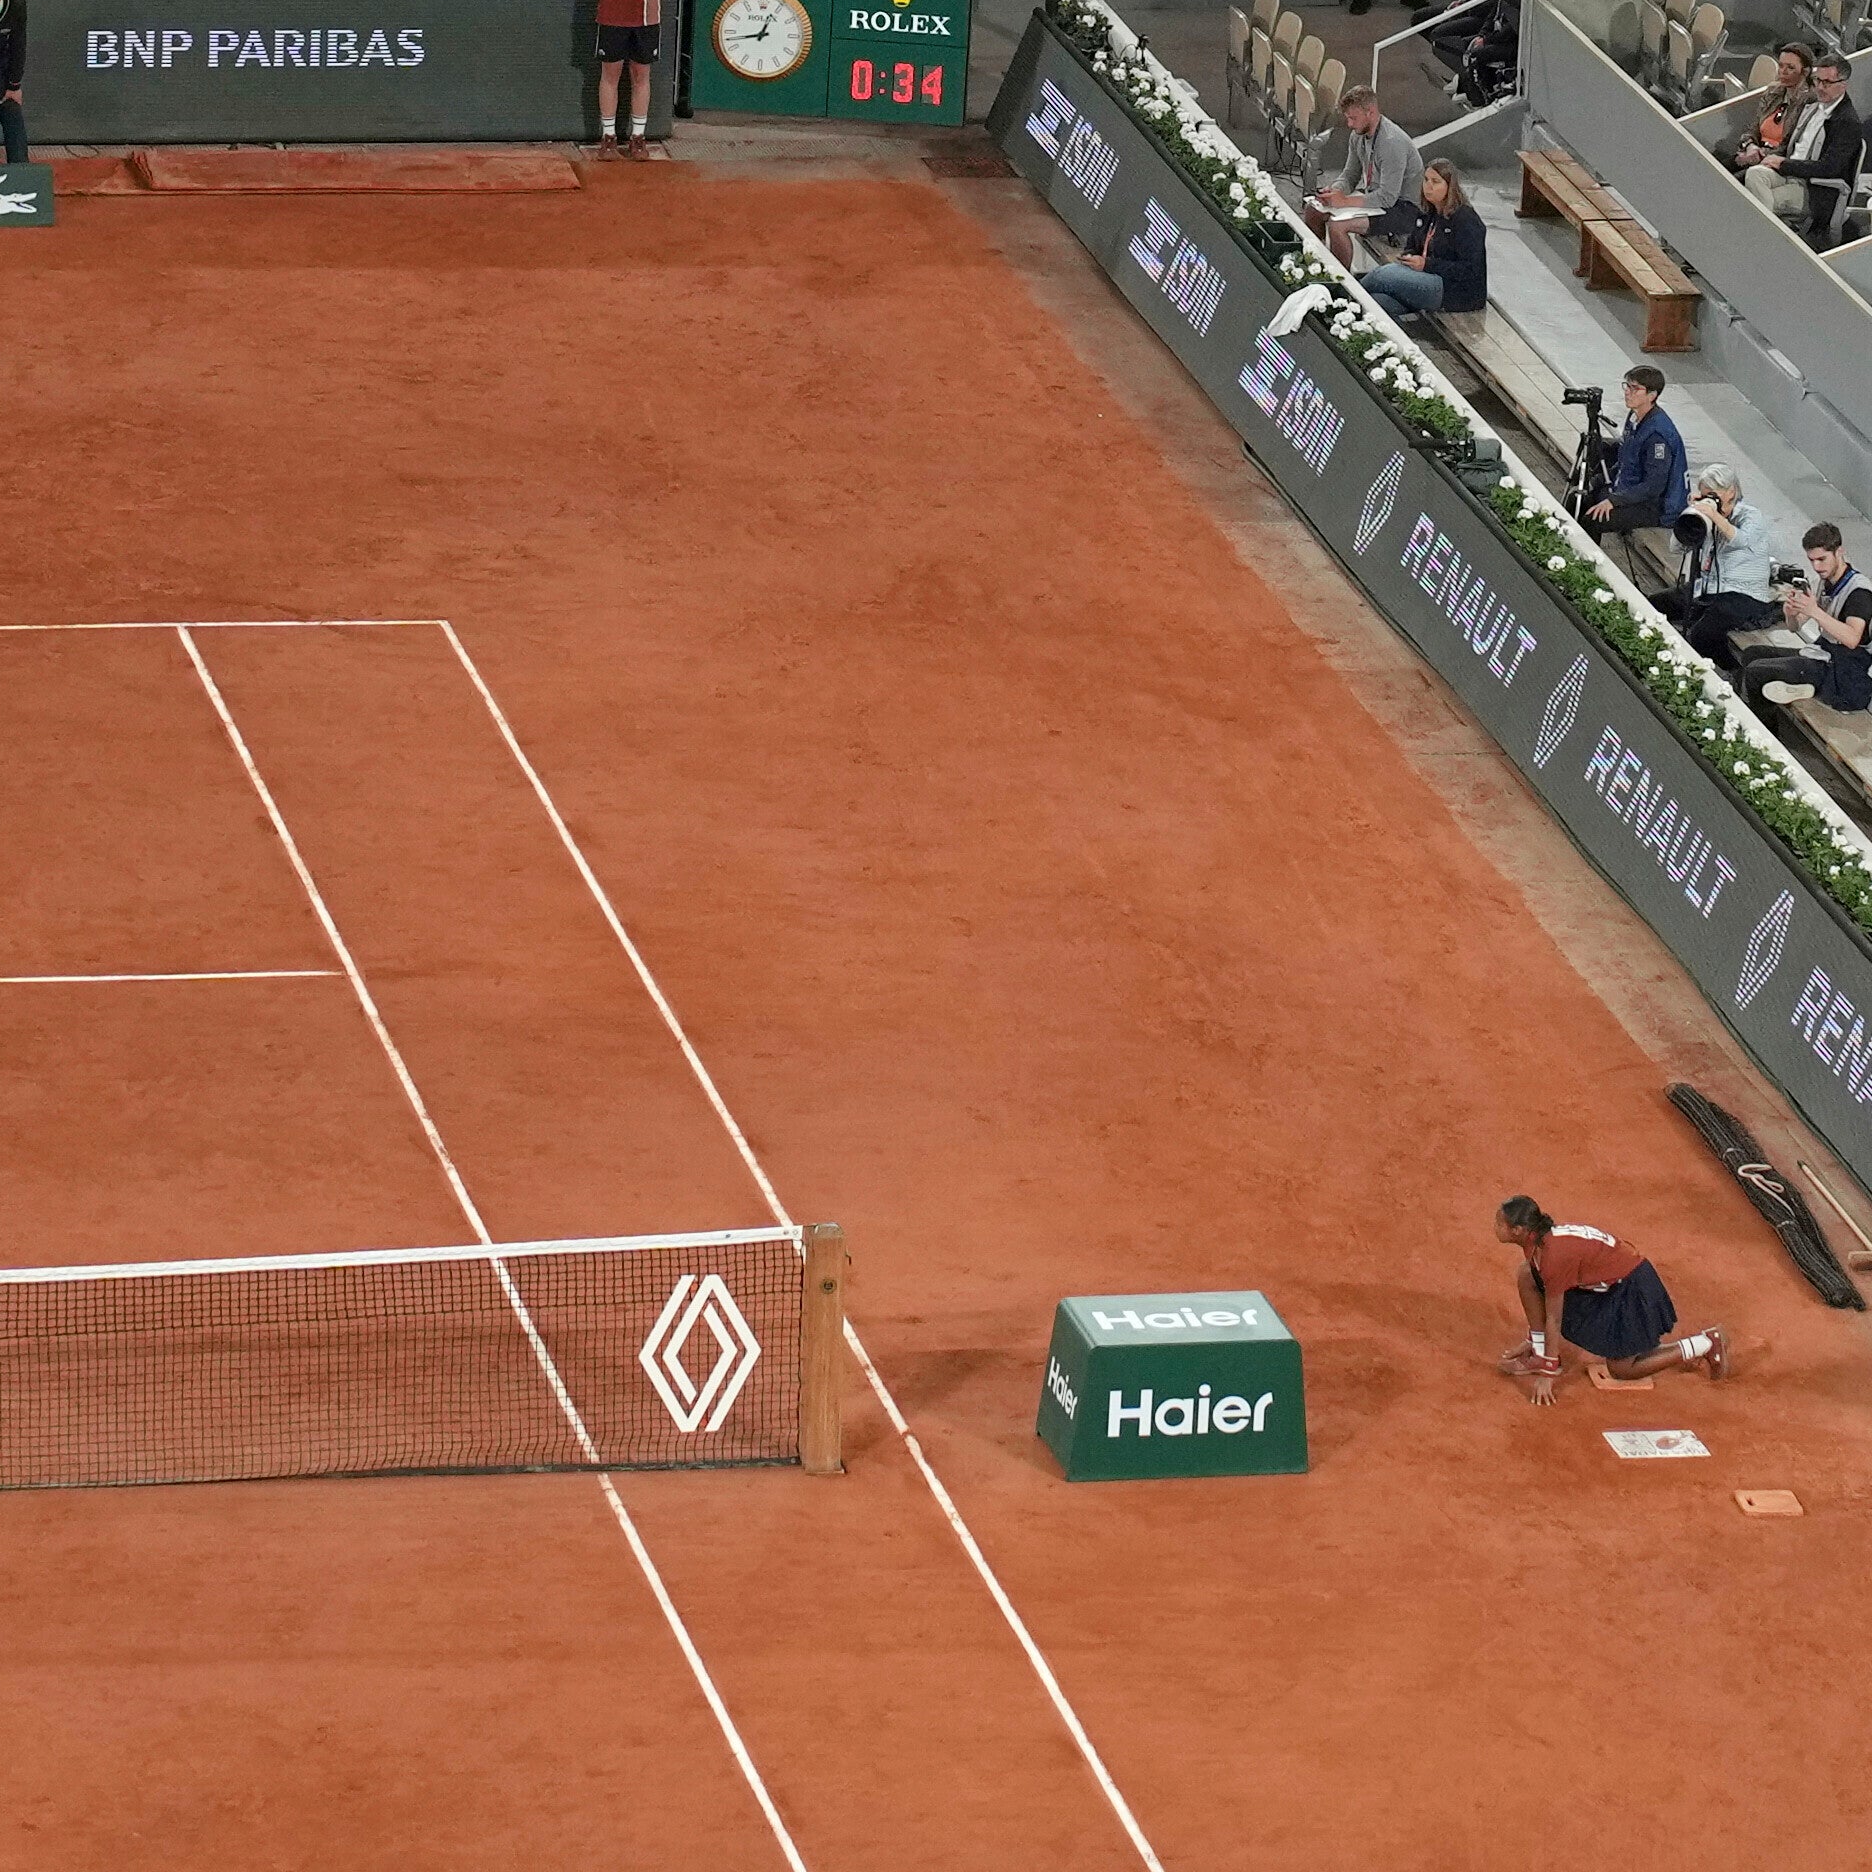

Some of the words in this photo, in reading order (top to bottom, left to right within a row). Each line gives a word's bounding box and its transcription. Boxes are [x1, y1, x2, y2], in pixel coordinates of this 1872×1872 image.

[86, 30, 193, 68] BNP
[207, 29, 425, 68] PARIBAS
[849, 9, 952, 36] ROLEX
[850, 58, 944, 107] 0:34
[1400, 511, 1537, 688] RENAULT
[1584, 724, 1737, 919] RENAULT
[1091, 1307, 1258, 1330] Haier
[1047, 1356, 1078, 1420] Haier
[1107, 1382, 1274, 1438] Haier
